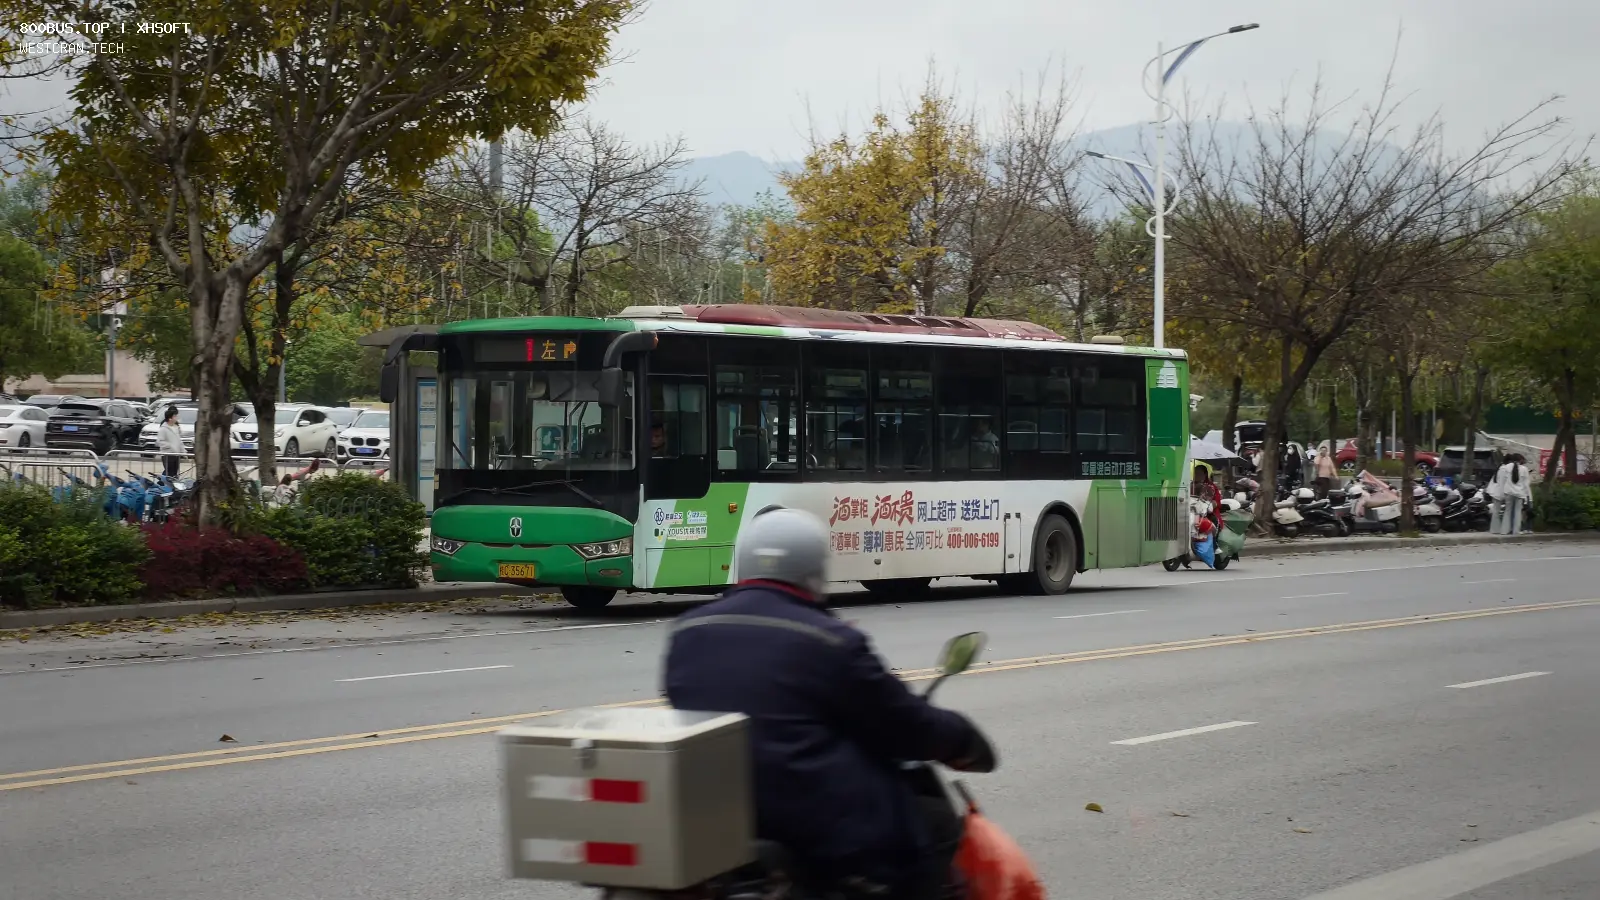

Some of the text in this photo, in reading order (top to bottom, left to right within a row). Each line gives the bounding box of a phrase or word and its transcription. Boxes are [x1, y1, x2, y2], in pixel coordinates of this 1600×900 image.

[541, 340, 556, 360] 左
[1081, 461, 1141, 476] 亚星混合动力客车
[829, 490, 1000, 528] 酒掌柜 酒不贵 网上超市 送货上门
[836, 532, 860, 551] 酒掌柜
[863, 530, 905, 553] 薄利惠民
[905, 530, 944, 551] 全网可比
[947, 532, 999, 549] 400-006-6199
